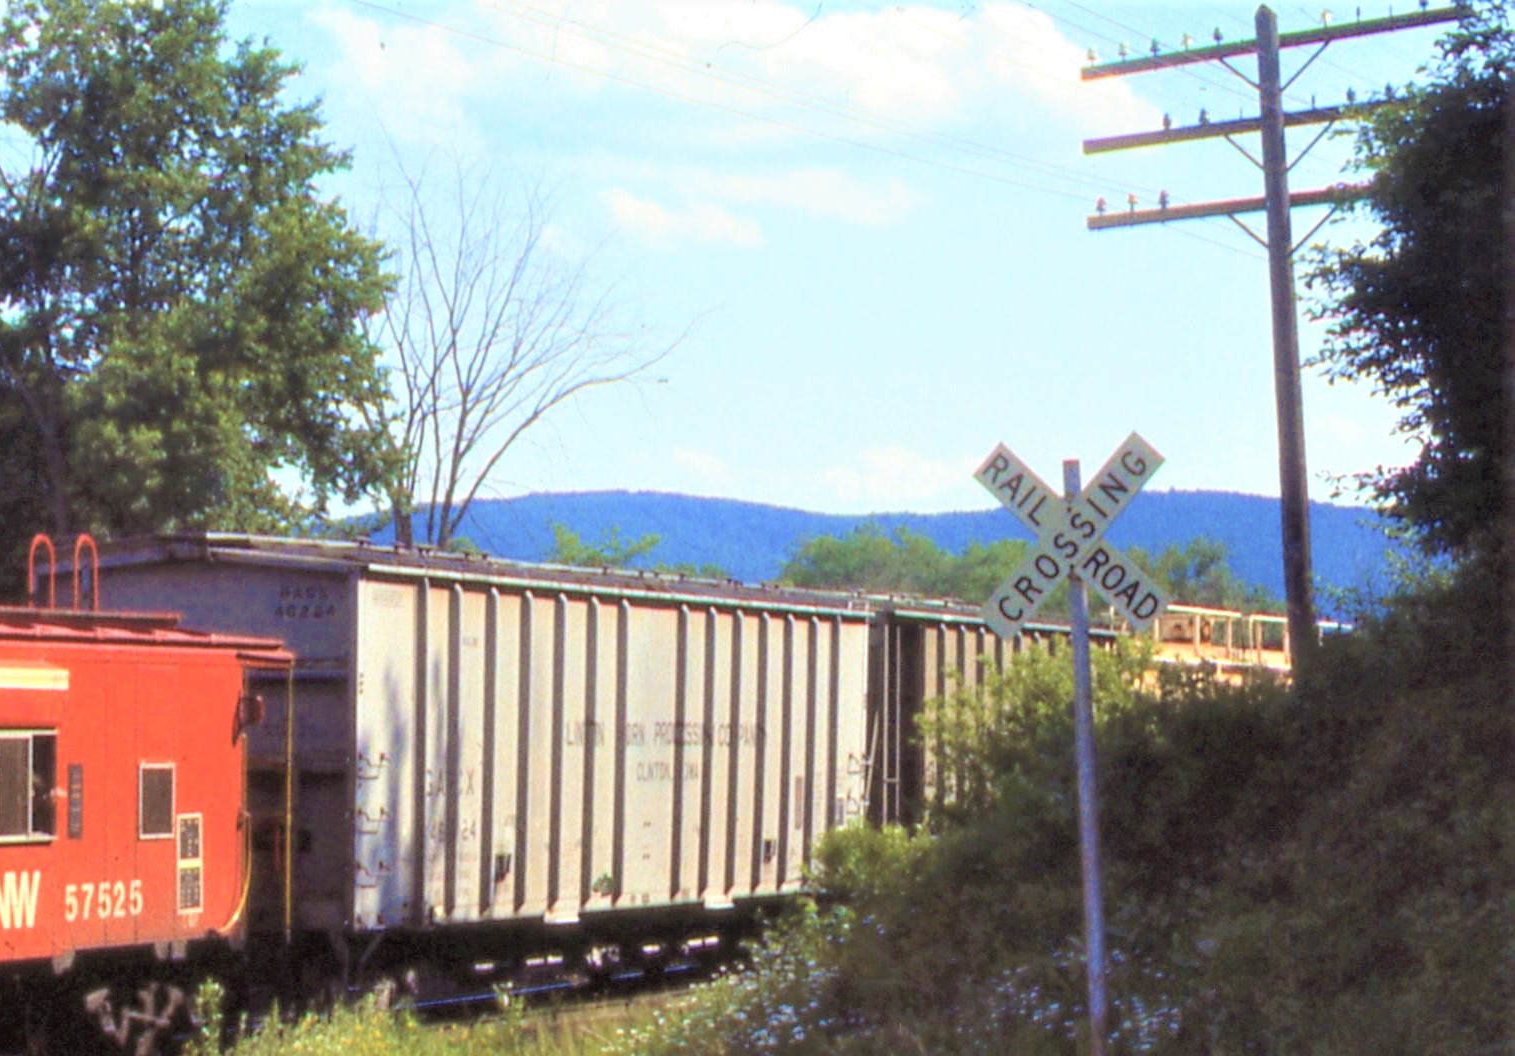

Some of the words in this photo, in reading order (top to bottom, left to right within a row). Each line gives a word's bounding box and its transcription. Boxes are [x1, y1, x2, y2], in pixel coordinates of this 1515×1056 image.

[983, 453, 1047, 527] RAIL
[1083, 547, 1158, 620] ROAD
[998, 451, 1147, 622] CROSSING
[65, 879, 144, 921] 57525
